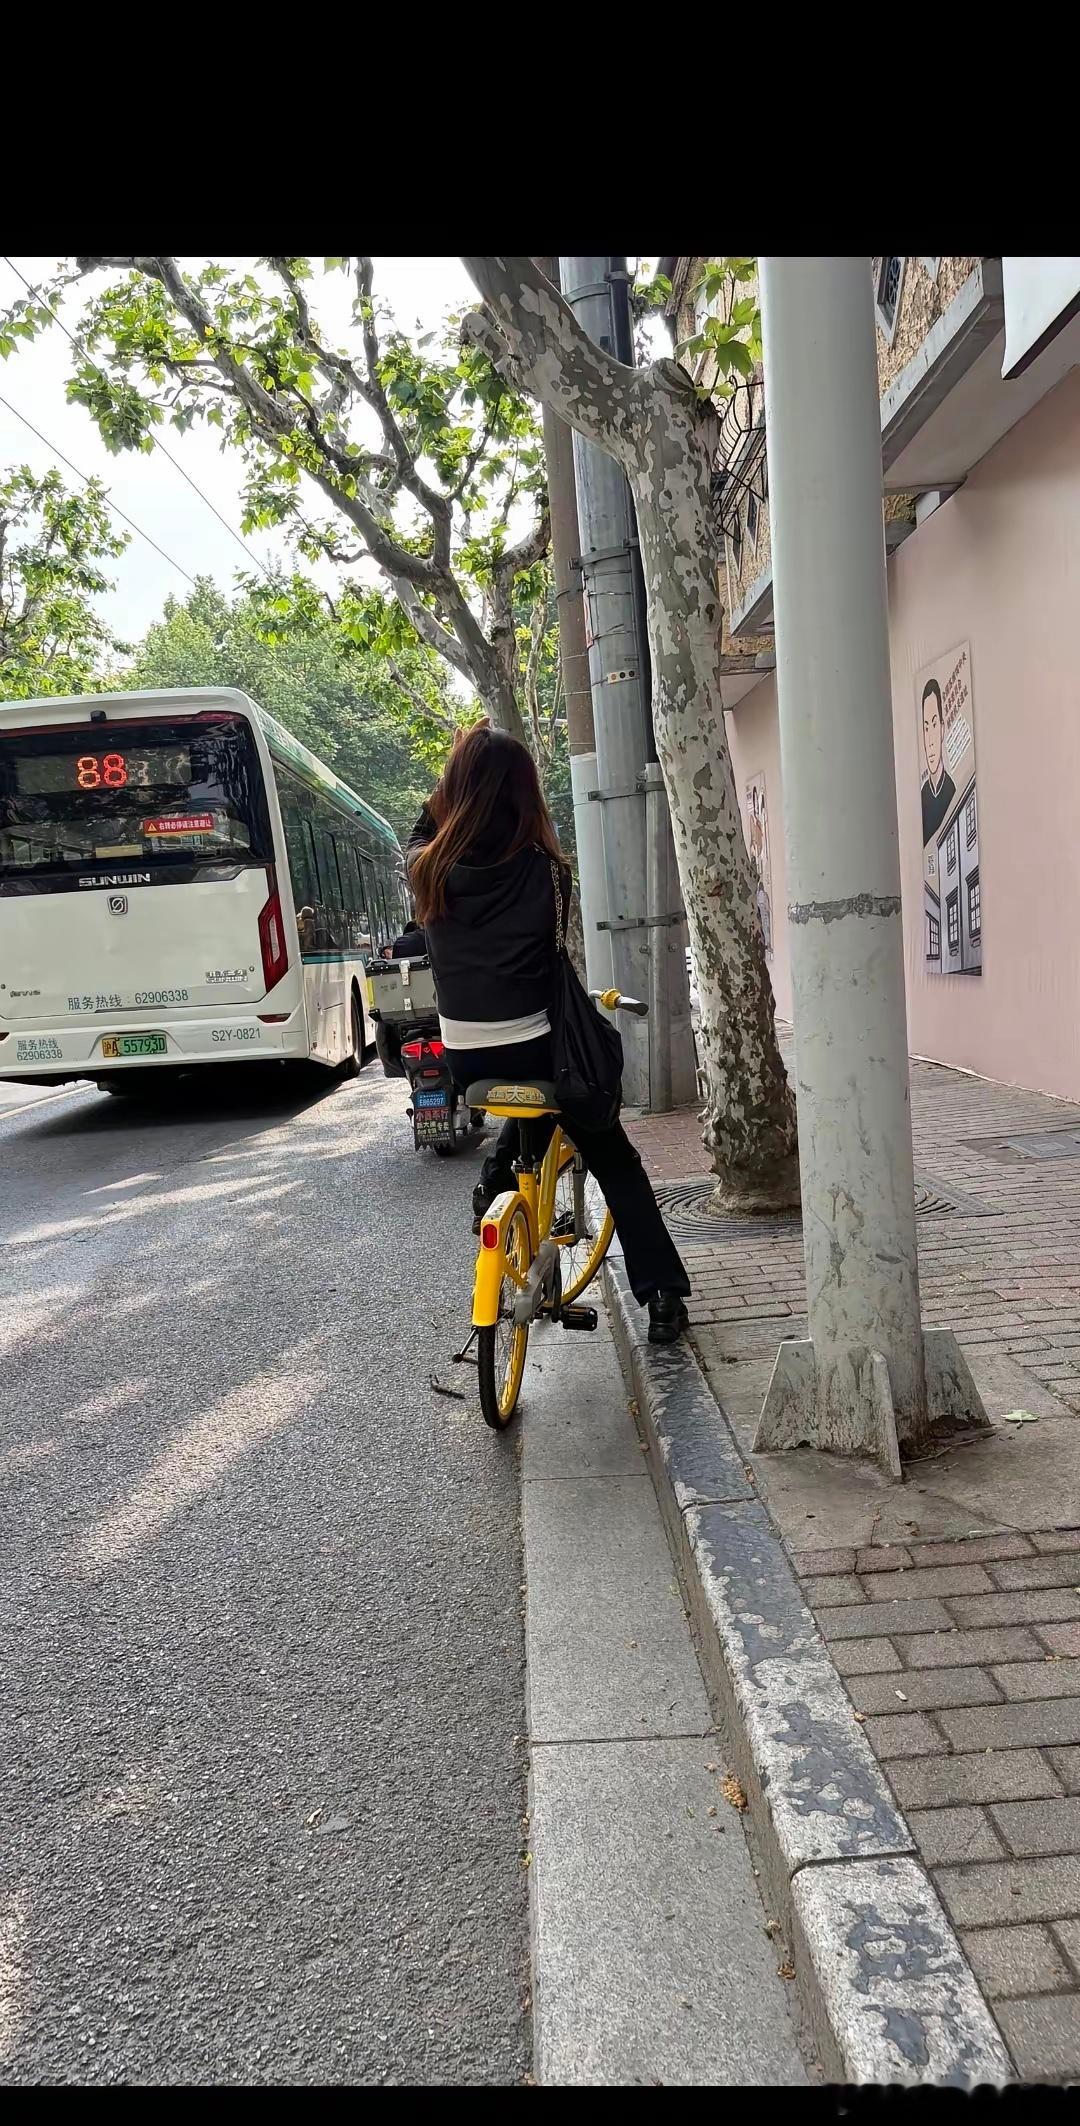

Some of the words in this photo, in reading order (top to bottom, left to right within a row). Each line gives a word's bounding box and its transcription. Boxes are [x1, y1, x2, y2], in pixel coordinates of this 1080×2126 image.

[77, 753, 127, 788] 88
[79, 873, 151, 887] SUNWIN
[135, 989, 188, 1004] 62906338
[211, 1027, 261, 1042] S2Y-0821
[17, 1038, 59, 1051] 服务热线
[17, 1050, 63, 1061] 62906338
